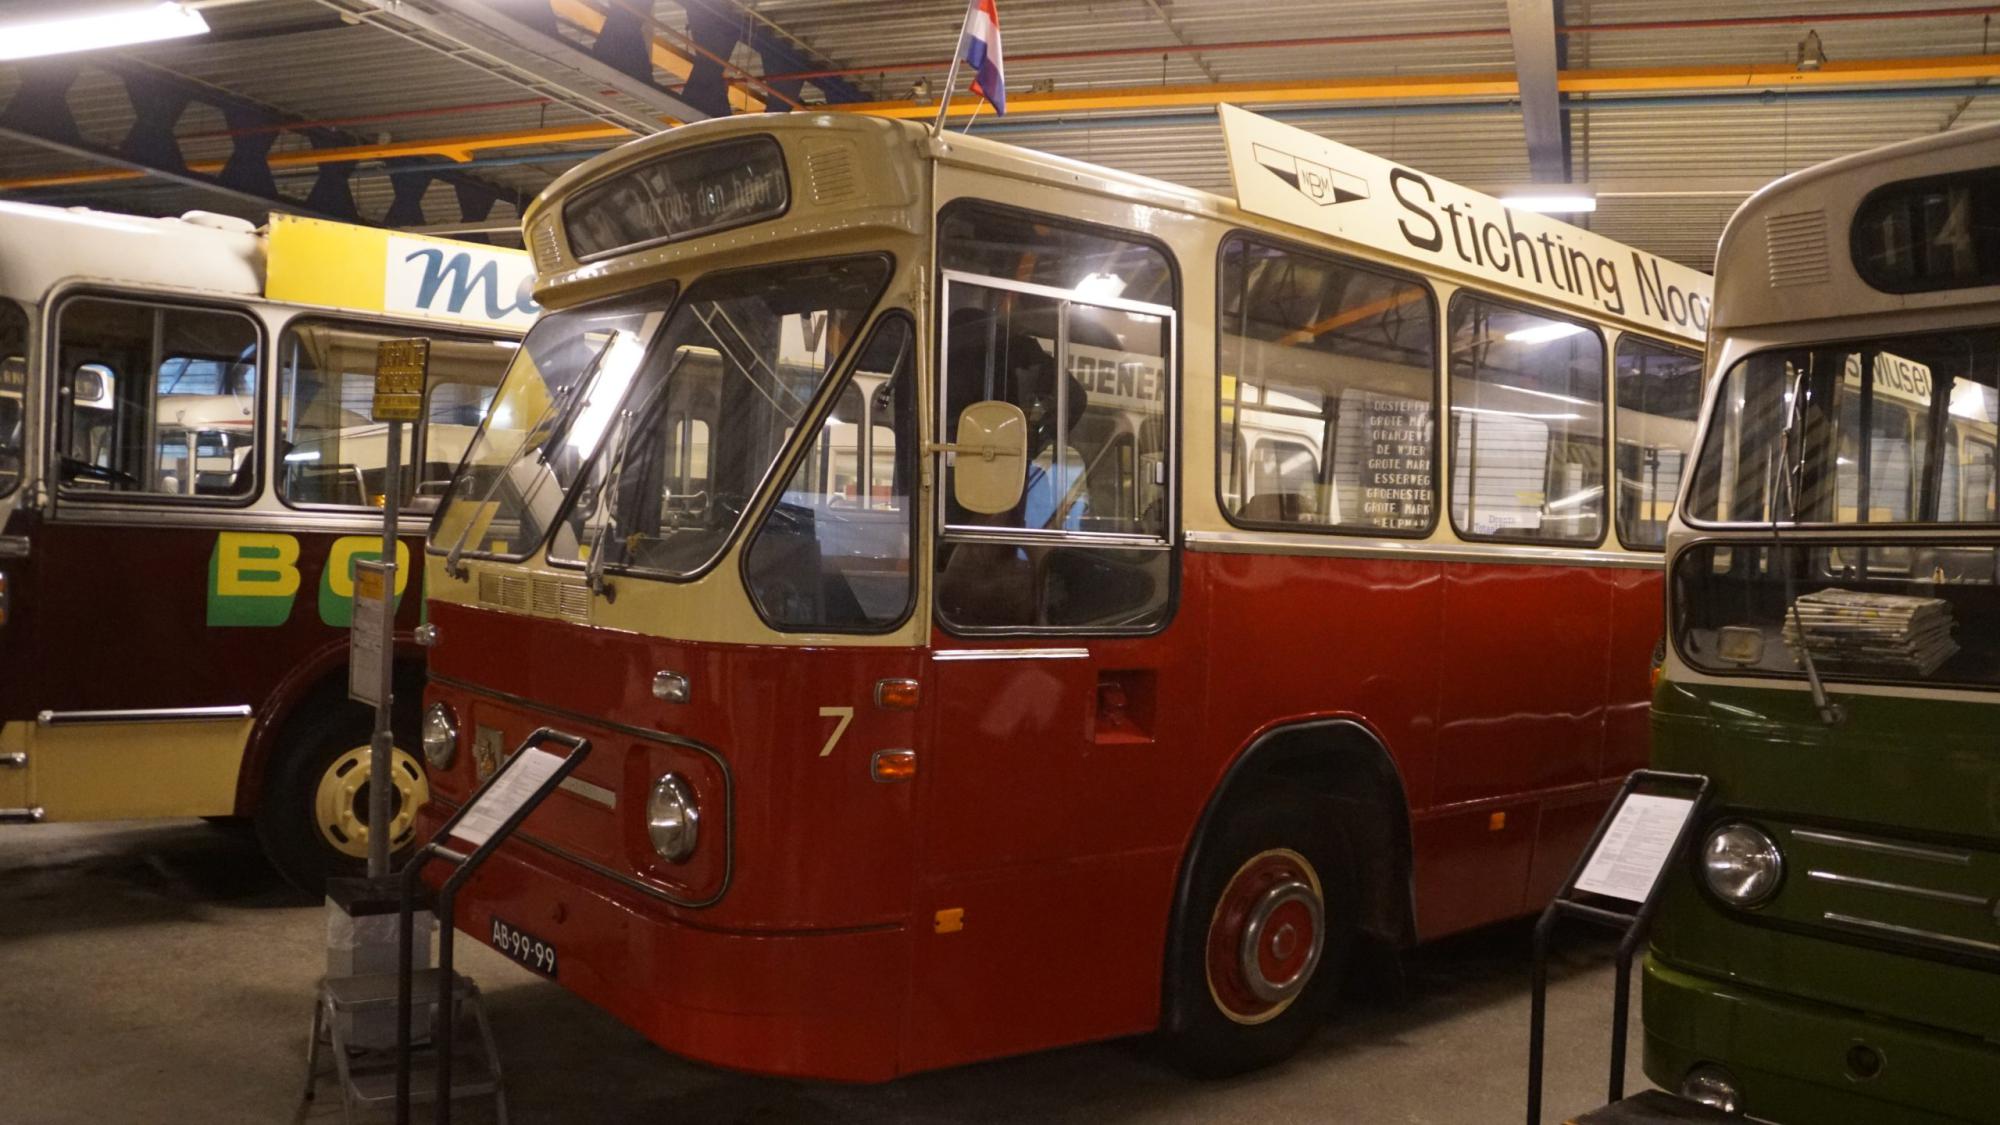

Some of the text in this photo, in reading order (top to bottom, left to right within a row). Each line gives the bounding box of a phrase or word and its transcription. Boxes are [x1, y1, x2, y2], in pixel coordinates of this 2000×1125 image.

[1301, 169, 1331, 199] NBM
[1389, 167, 1711, 332] Stichting Noo
[1368, 458, 1401, 470] GROTE
[1376, 444, 1391, 455] DE
[1363, 502, 1397, 515] GROTE
[818, 706, 854, 757] 7
[492, 920, 555, 973] AB-99-99
